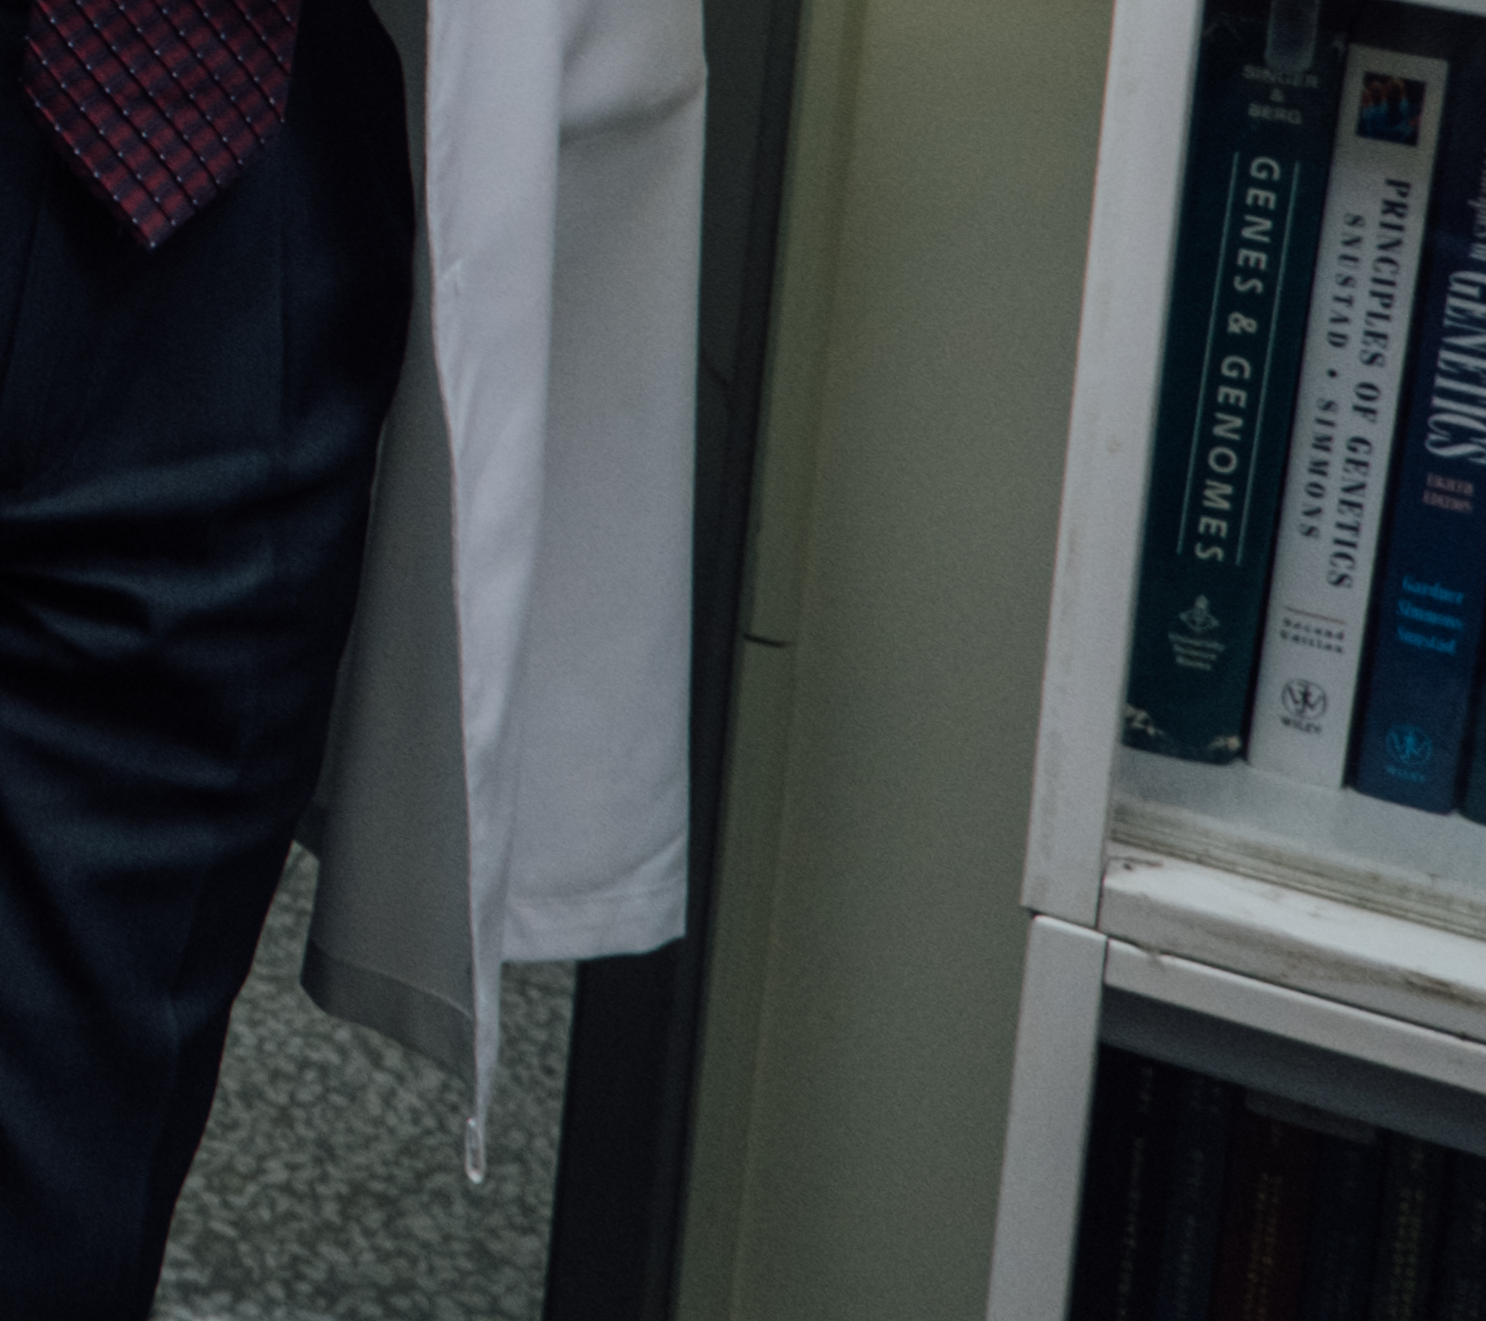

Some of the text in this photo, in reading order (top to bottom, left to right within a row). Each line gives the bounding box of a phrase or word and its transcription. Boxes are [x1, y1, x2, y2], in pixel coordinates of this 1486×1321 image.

[1193, 155, 1282, 564] GENES & GENOMES
[1298, 212, 1367, 542] SNUSTAD SIMMONS
[1326, 178, 1412, 590] PRINCIPLES OF GENETICS
